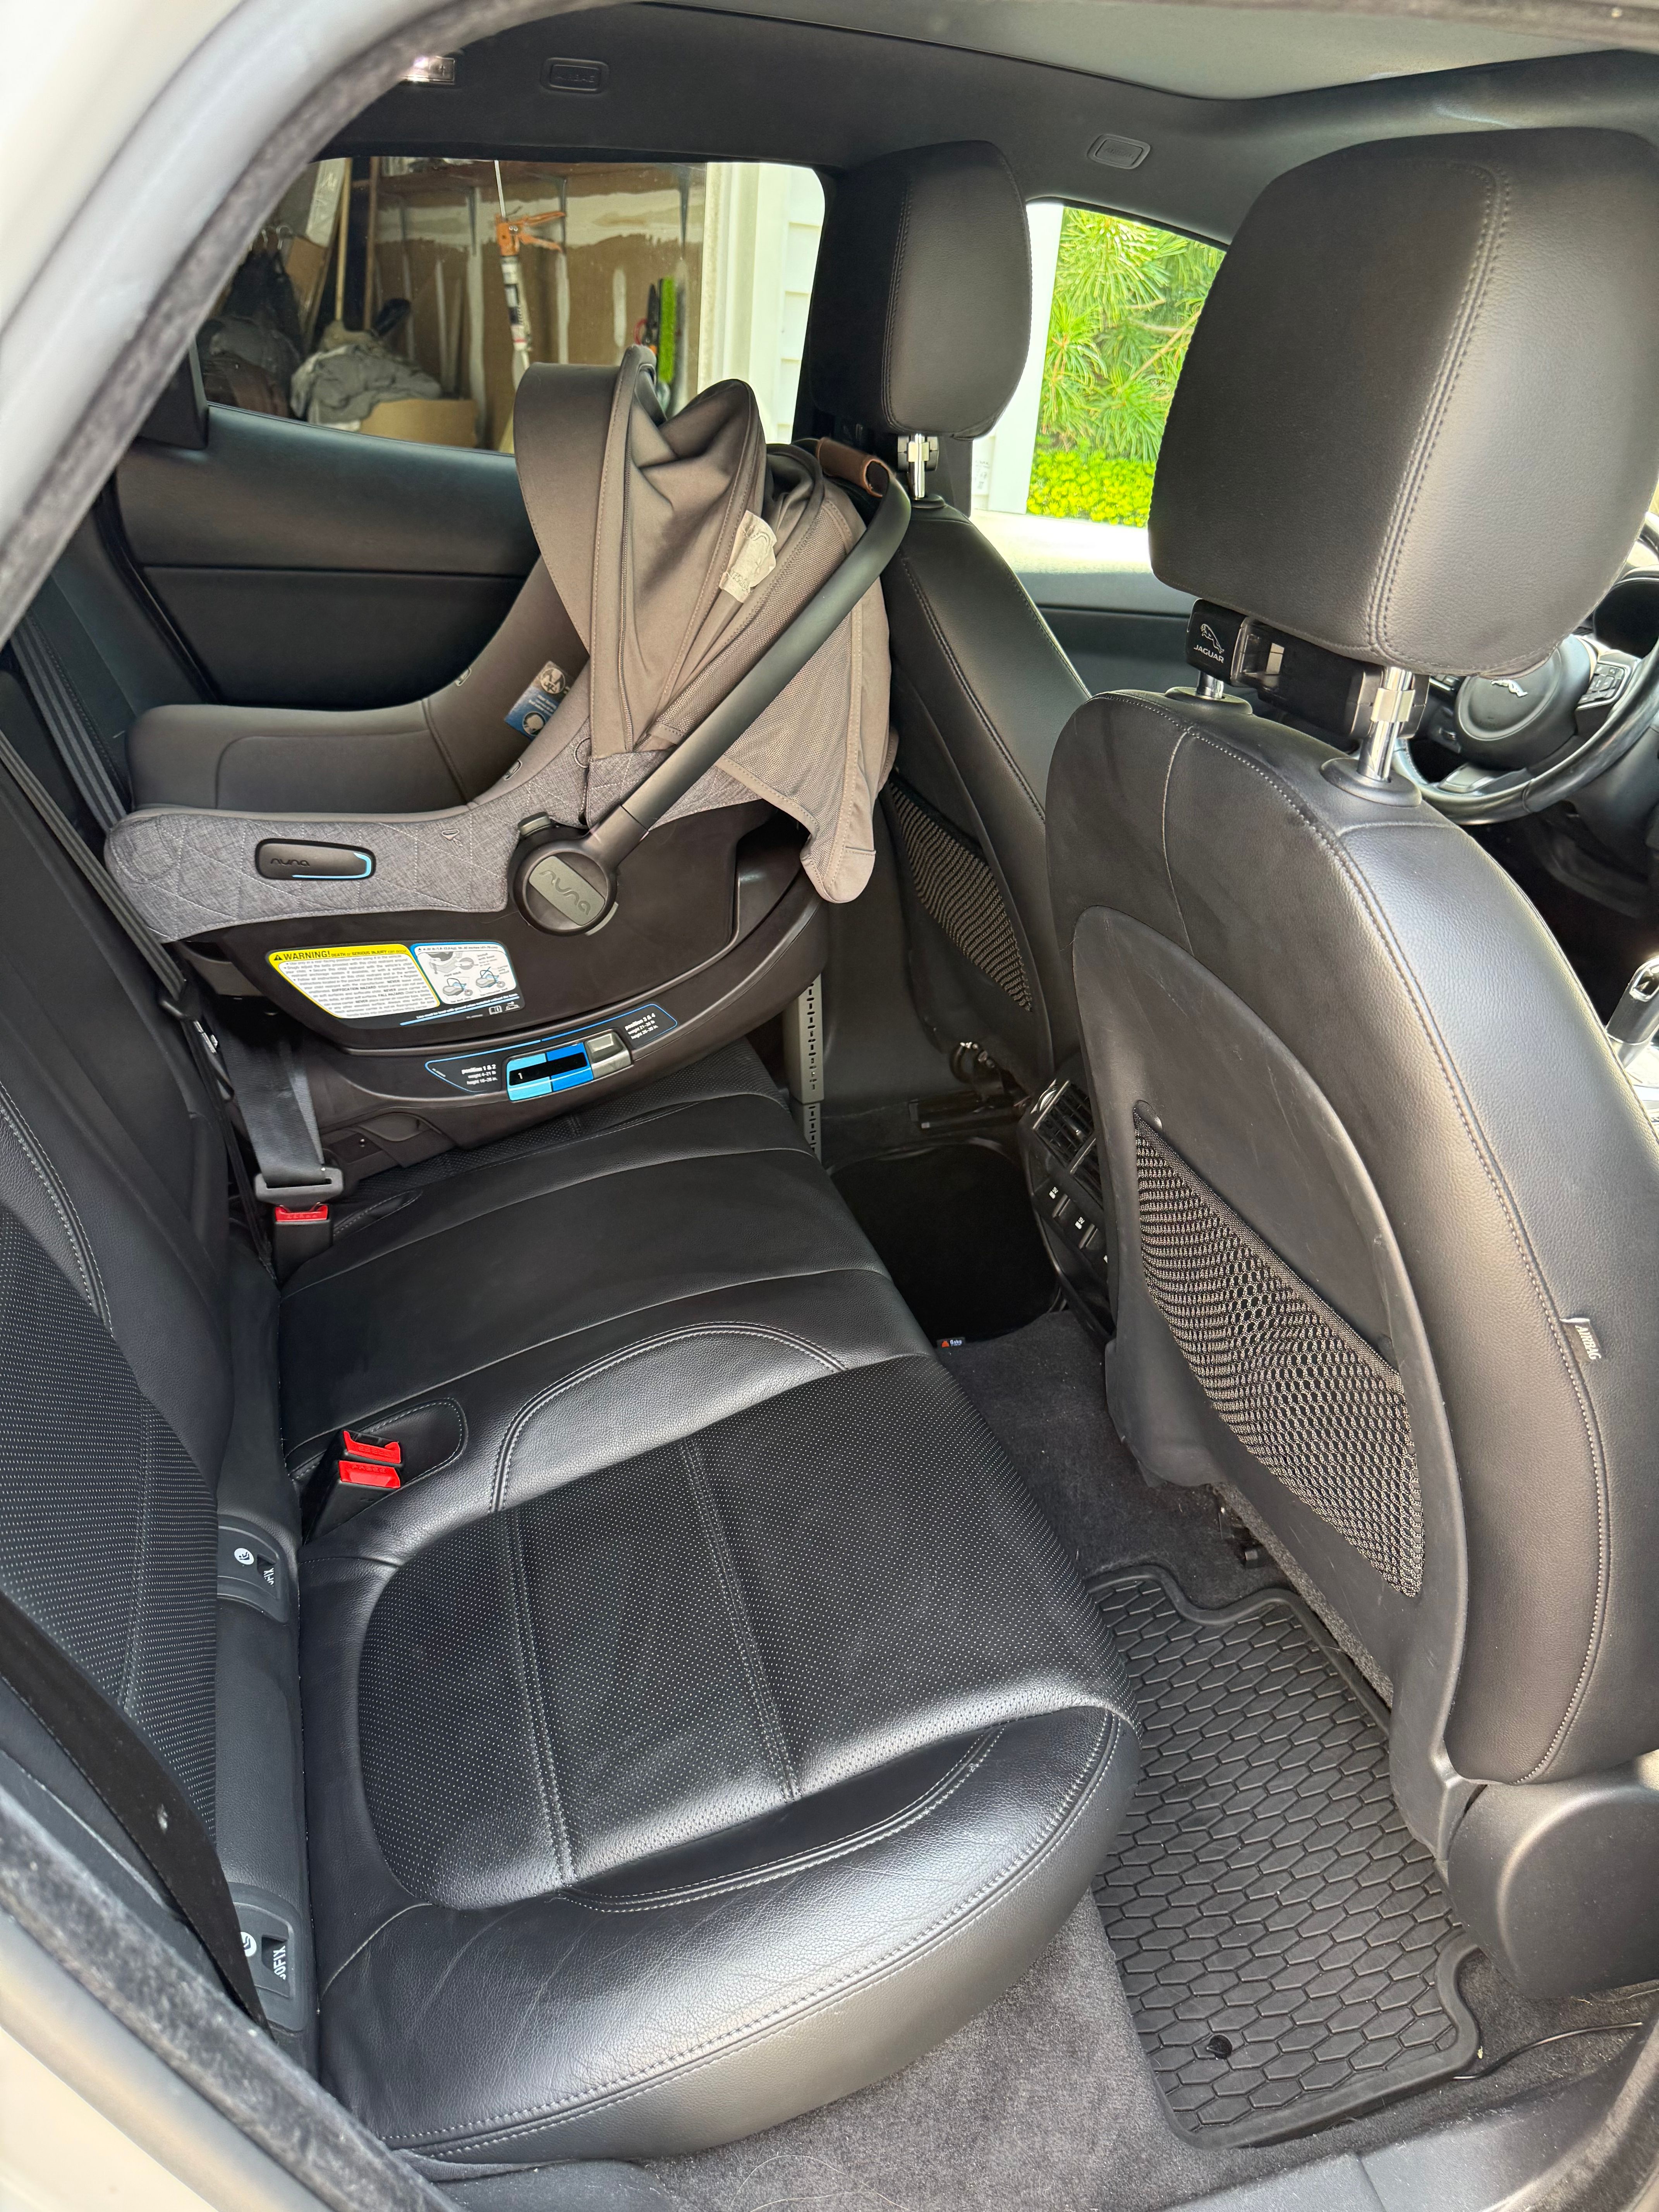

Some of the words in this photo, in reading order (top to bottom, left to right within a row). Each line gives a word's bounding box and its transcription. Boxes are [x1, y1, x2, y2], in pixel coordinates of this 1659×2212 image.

[1194, 644, 1224, 663] JAGUAR
[270, 858, 310, 866] nuna
[539, 870, 591, 916] nuna
[283, 950, 330, 960] WARNING!
[1575, 1325, 1602, 1360] AIRBAG
[263, 1568, 274, 1587] OFIX
